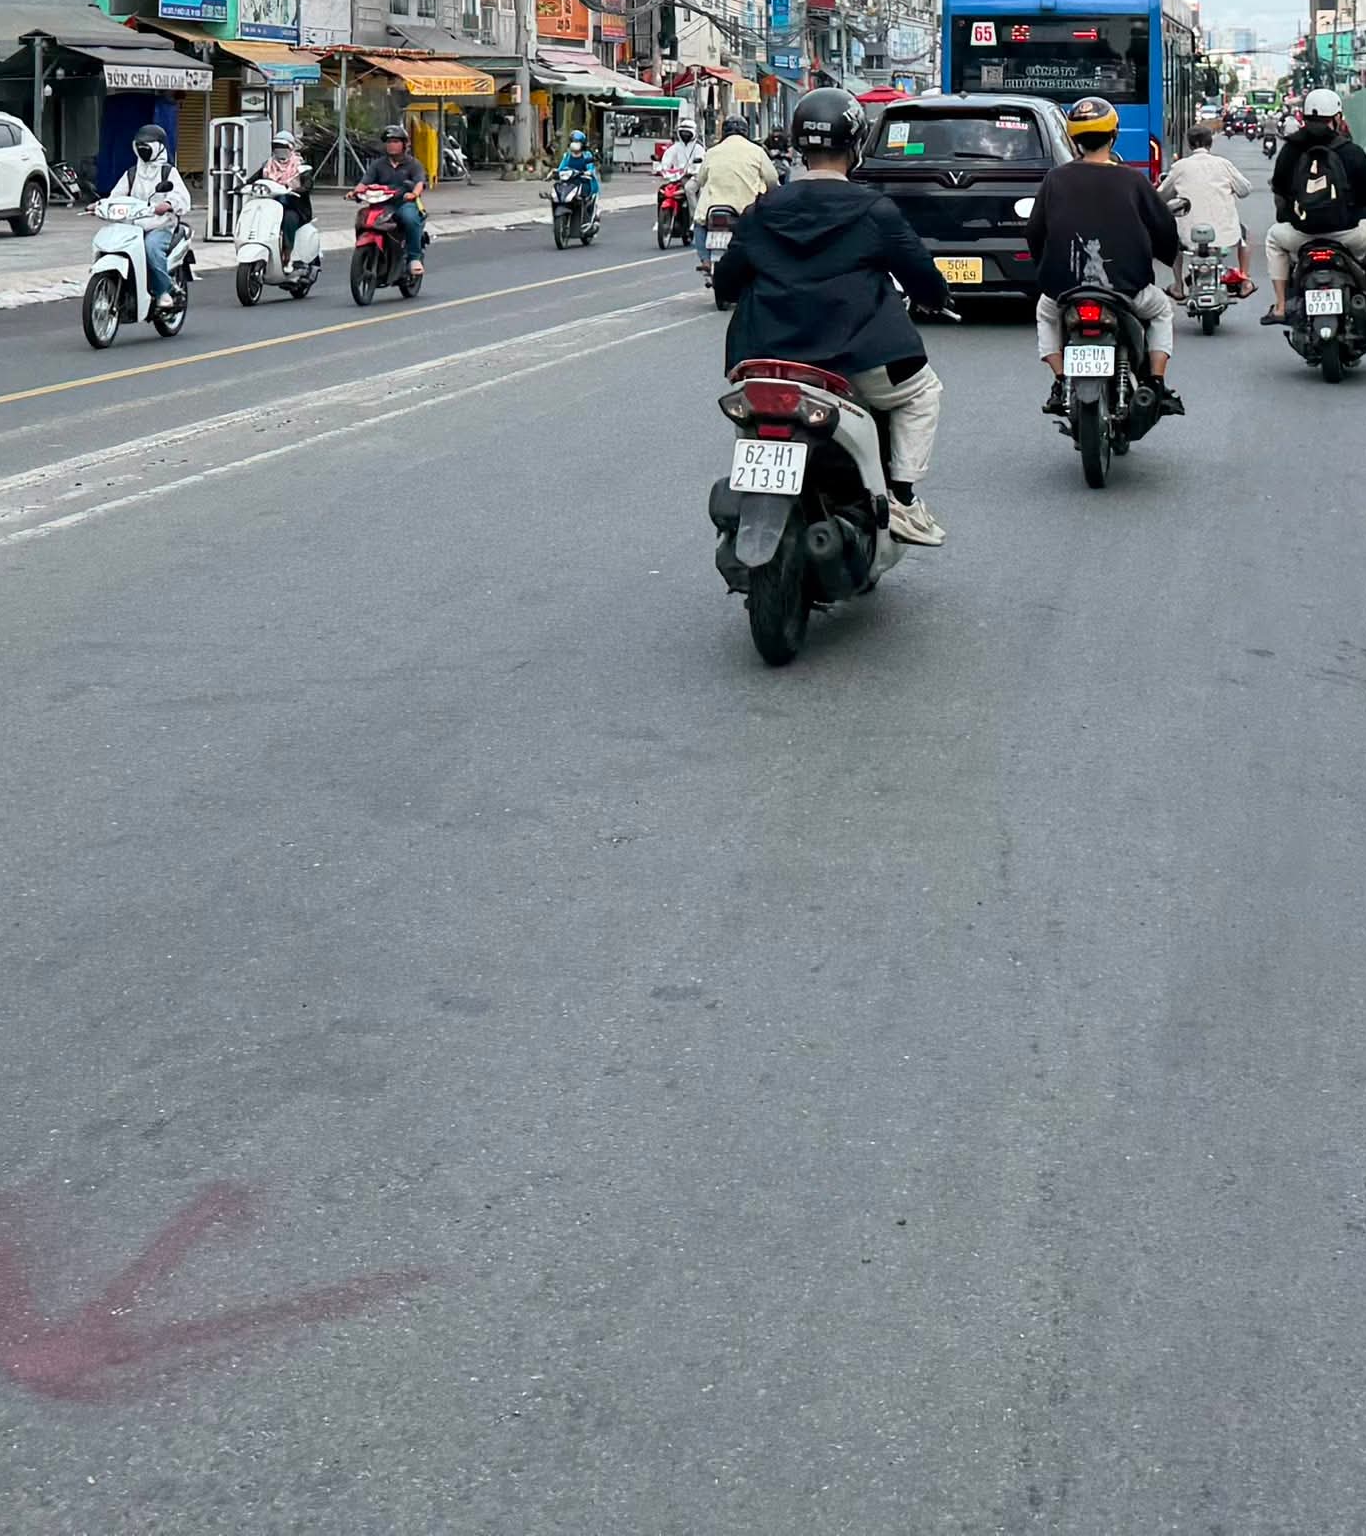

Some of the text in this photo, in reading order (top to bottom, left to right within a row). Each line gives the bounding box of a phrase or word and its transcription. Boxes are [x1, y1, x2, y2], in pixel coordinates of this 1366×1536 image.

[974, 25, 993, 42] 65
[107, 68, 128, 86] BÚN
[130, 68, 153, 87] CHẢ
[745, 444, 793, 467] 62-H1
[733, 467, 798, 492] 213.91
